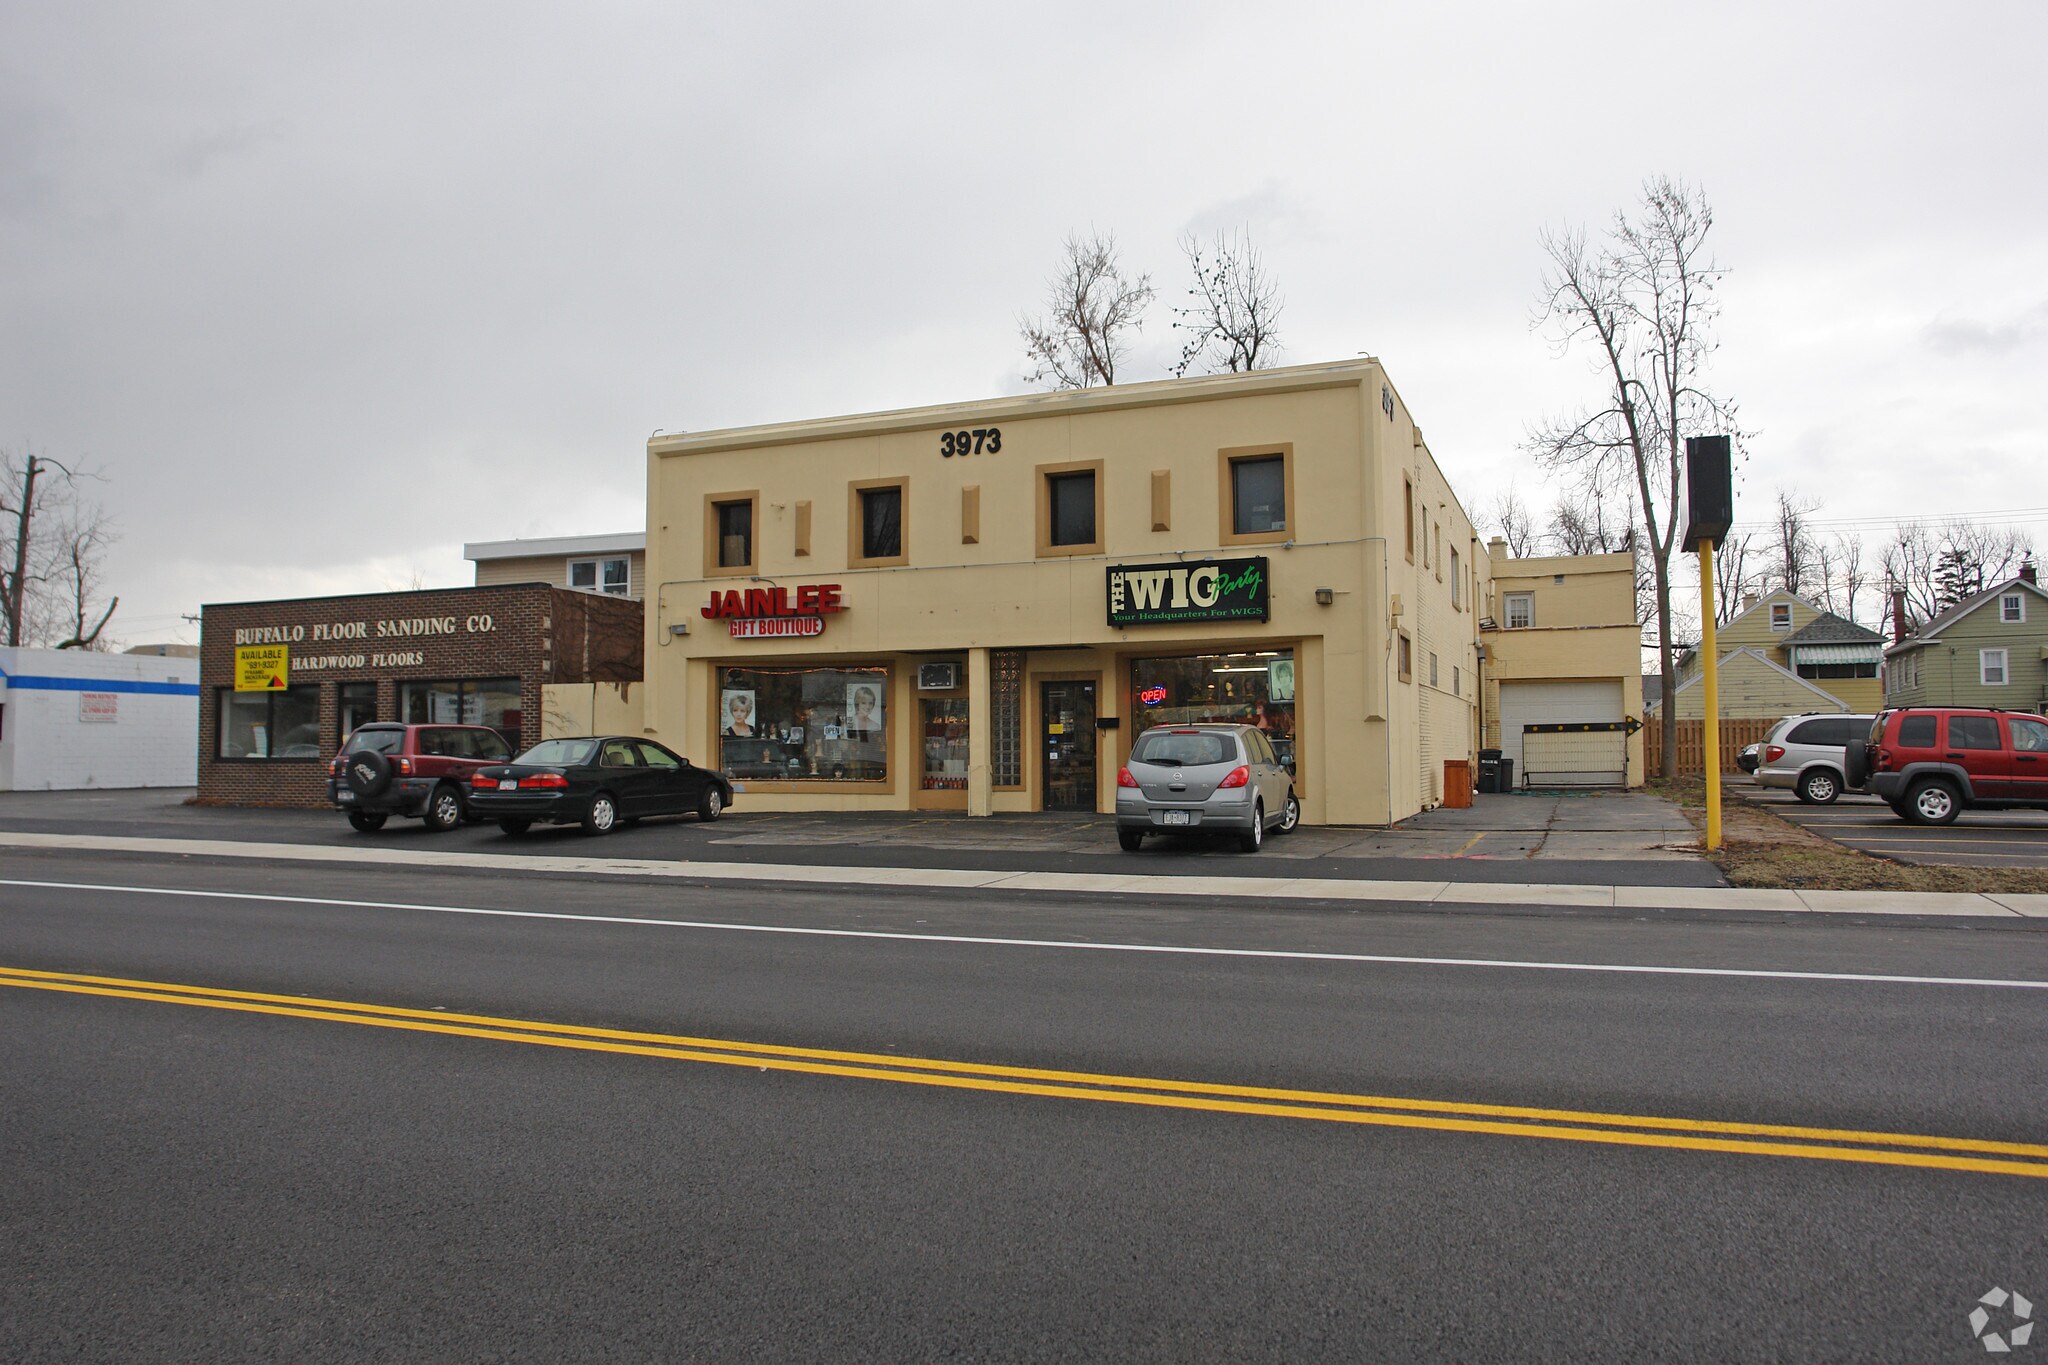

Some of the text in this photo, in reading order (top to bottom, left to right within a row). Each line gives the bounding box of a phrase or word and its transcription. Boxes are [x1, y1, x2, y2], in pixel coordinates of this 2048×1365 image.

[941, 428, 1001, 458] 3973
[1111, 572, 1125, 613] THE
[1125, 564, 1263, 610] WIG Party
[701, 584, 842, 619] JAINLEE
[1139, 611, 1207, 620] Headquarters
[1211, 609, 1228, 617] For
[1230, 607, 1263, 616] WIGS
[235, 614, 496, 645] BUFFALO FLOOR SANDING CO.
[729, 618, 819, 636] GIFT BOUTIQUE
[241, 650, 282, 659] AVAILABLE
[291, 651, 424, 671] HARDWOOD FLOORS
[1141, 688, 1167, 702] OPEN
